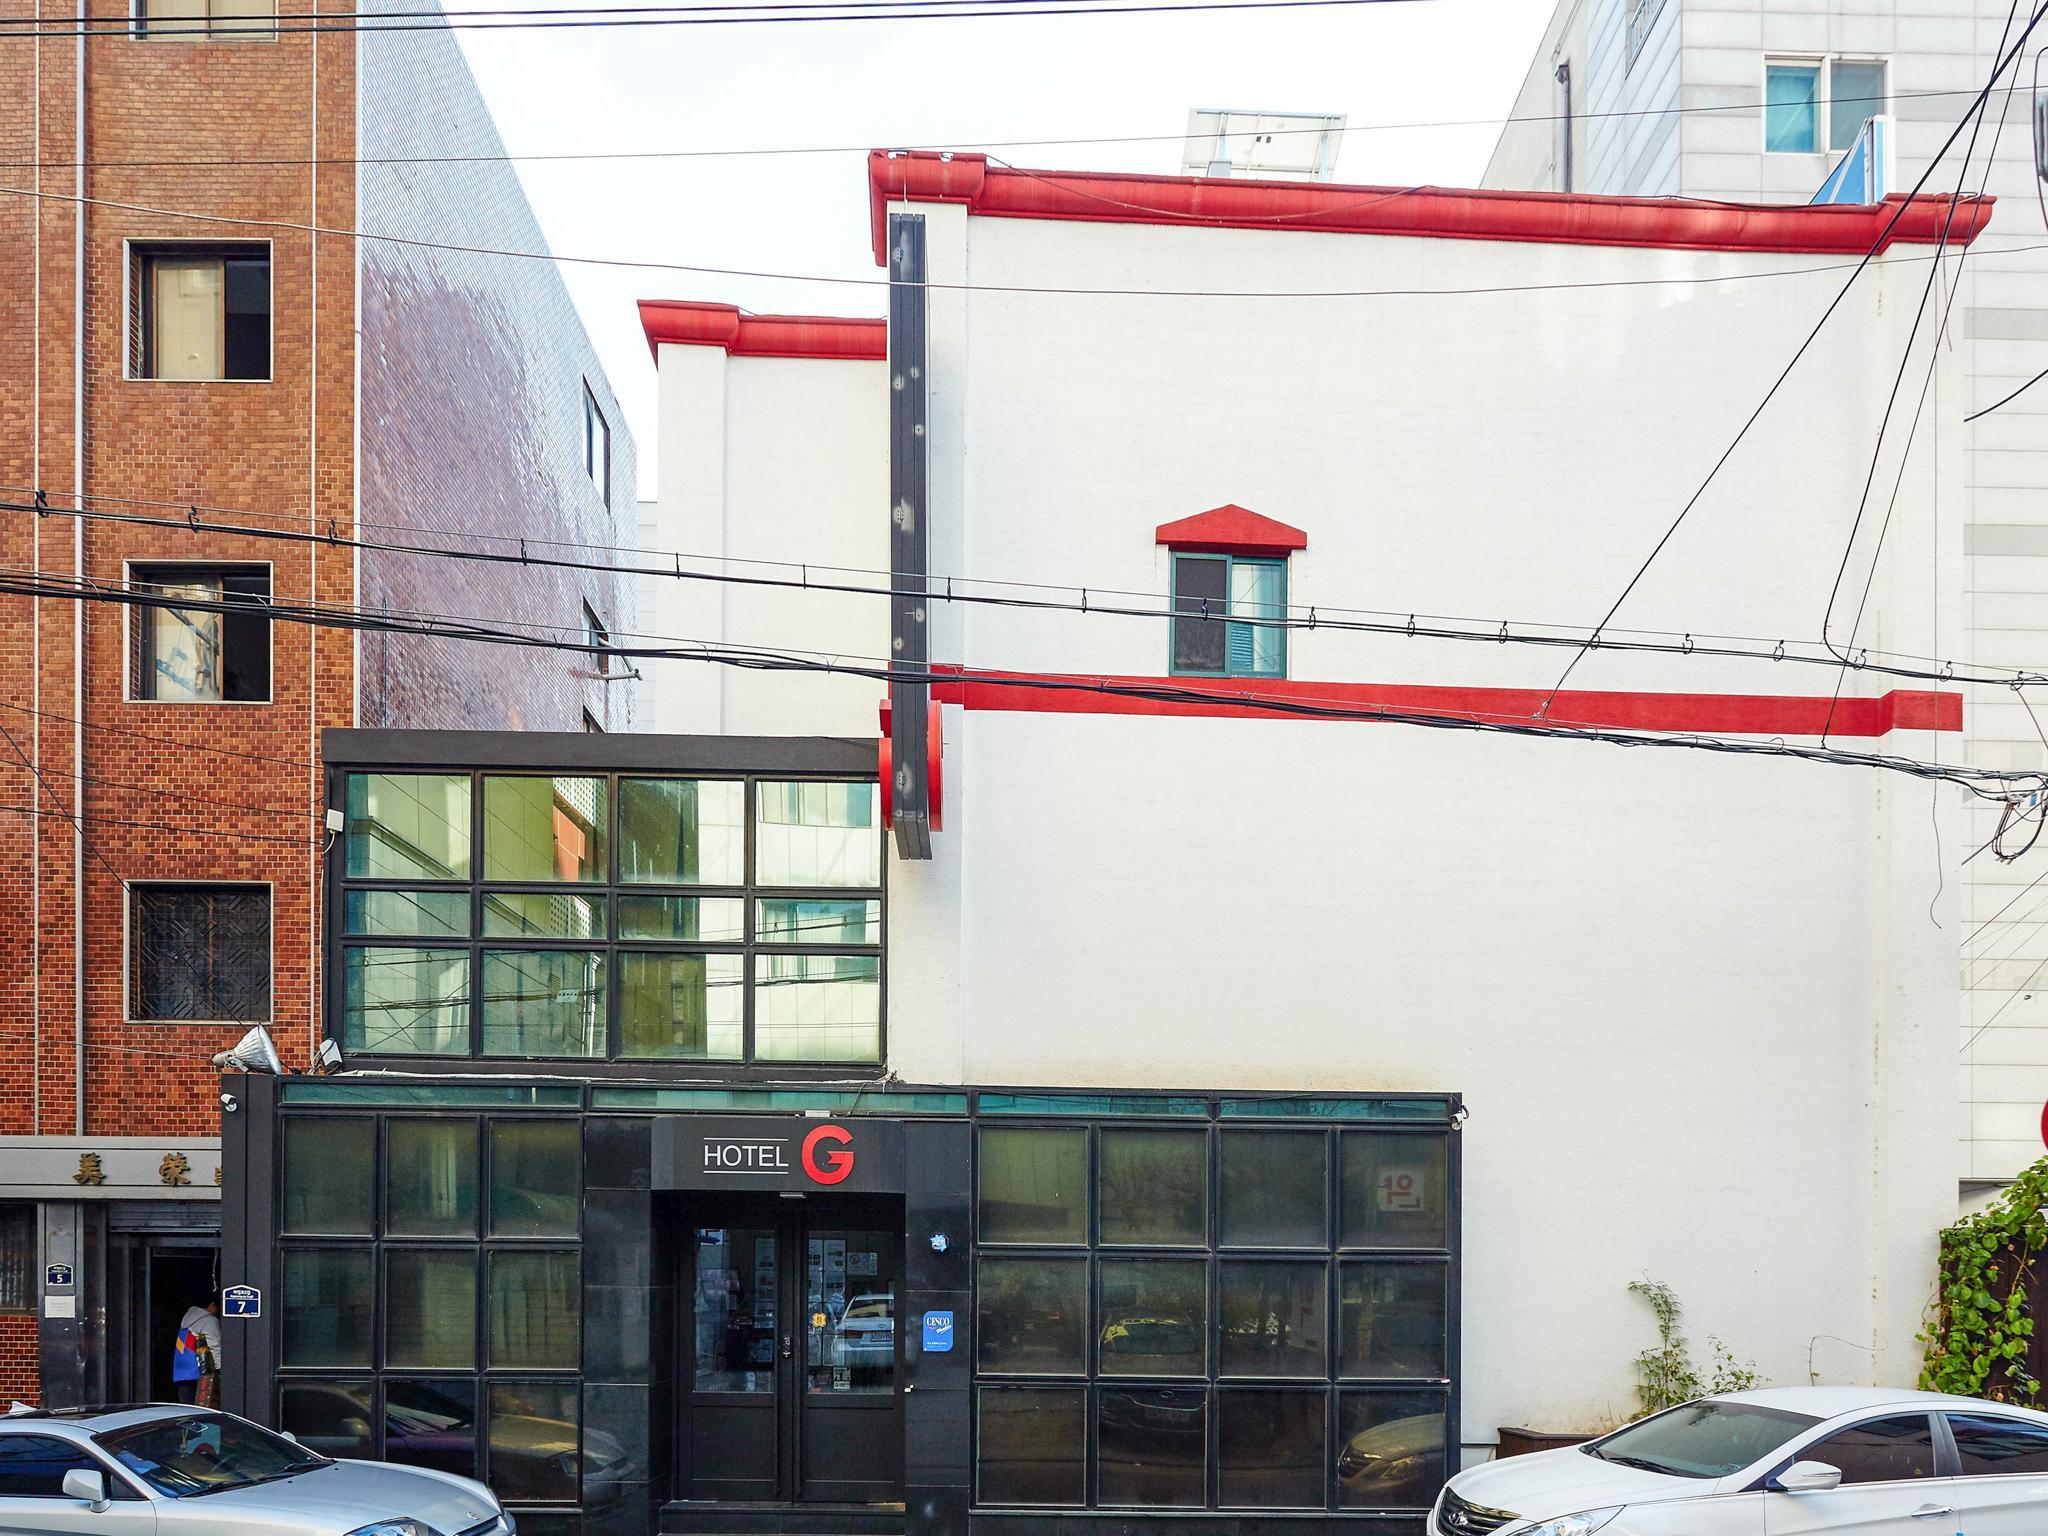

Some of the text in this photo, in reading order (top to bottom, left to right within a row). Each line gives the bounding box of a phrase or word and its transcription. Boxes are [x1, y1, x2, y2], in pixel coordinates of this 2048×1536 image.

[704, 1124, 855, 1185] HOTEL G
[57, 1274, 63, 1283] 5
[237, 1301, 246, 1313] 7
[926, 1316, 951, 1326] CESCO
